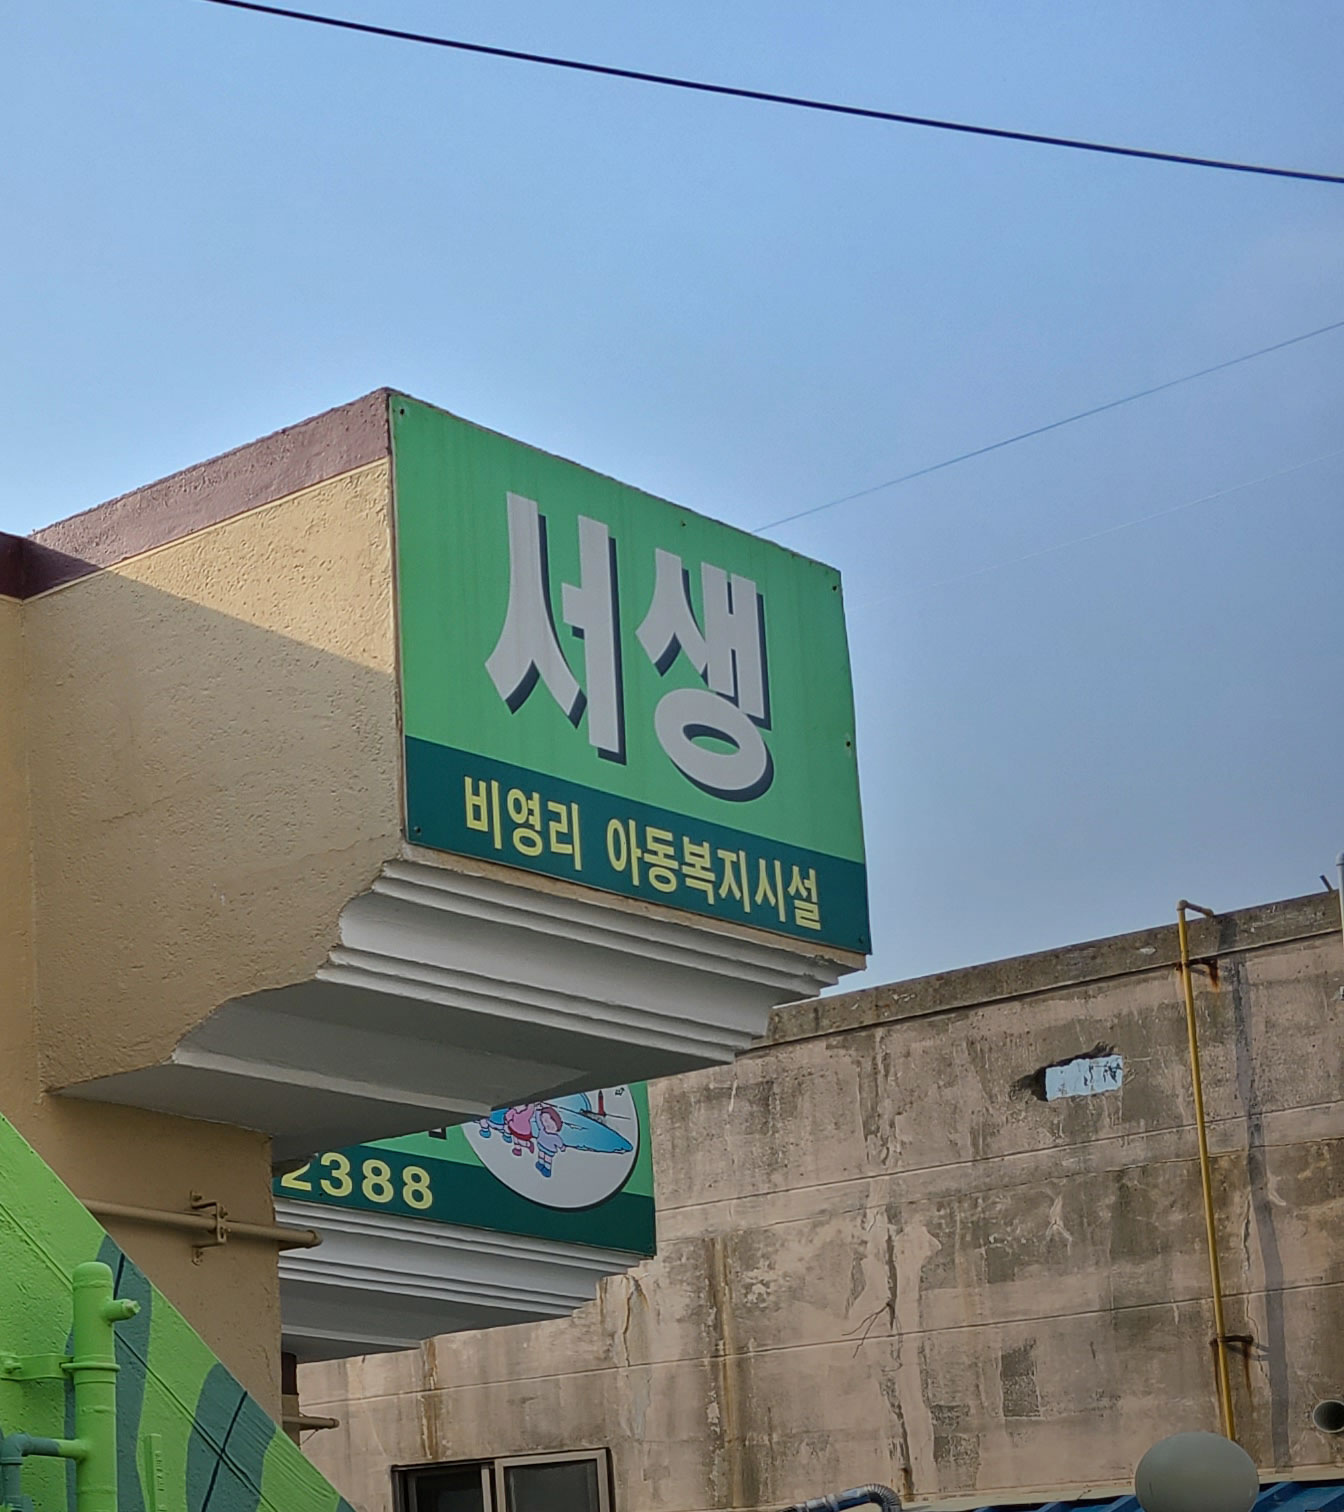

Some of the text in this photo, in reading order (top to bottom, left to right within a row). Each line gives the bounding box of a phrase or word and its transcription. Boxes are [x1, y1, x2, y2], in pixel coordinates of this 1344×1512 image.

[485, 491, 772, 800] 서생
[463, 775, 823, 931] 비영리 아동복지시설
